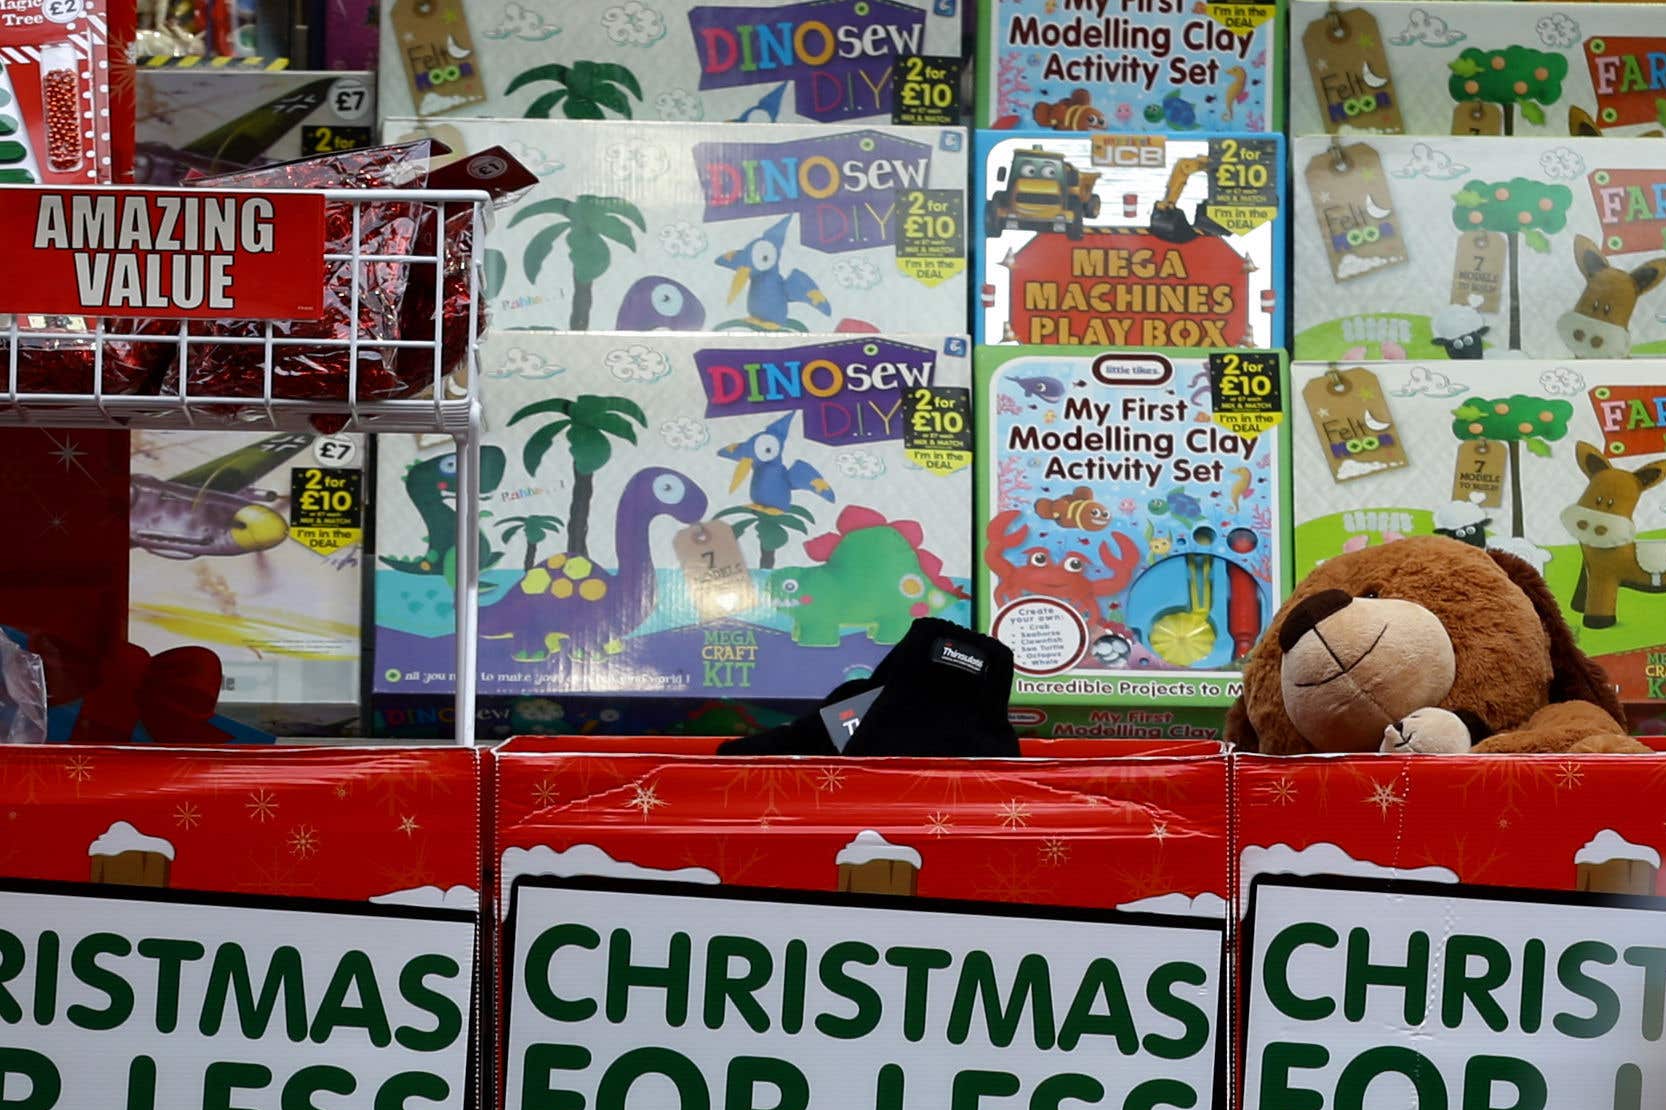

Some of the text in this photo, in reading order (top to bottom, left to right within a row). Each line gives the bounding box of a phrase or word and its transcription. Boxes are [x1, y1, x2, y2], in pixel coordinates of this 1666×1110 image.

[2, 13, 43, 26] Tree
[1009, 16, 1254, 59] Modelling Clay
[906, 57, 946, 79] 2 for
[1043, 53, 1220, 90] Activity Set
[811, 66, 893, 112] DIY
[901, 82, 952, 107] £10
[336, 91, 365, 111] £7
[315, 127, 356, 151] 2 for
[1221, 139, 1260, 161] 2 for
[1216, 164, 1268, 187] £10
[909, 191, 948, 213] 2 for
[34, 194, 275, 253] AMAZING
[816, 202, 896, 243] DIY
[904, 215, 956, 238] £10
[1072, 248, 1188, 279] MEGA
[74, 252, 235, 309] VALUE
[1024, 281, 1235, 315] MACHINES
[1030, 316, 1229, 347] PLAY BOX
[1223, 354, 1263, 374] 2 for
[1219, 376, 1272, 396] £10
[915, 389, 956, 409] 2 for
[820, 399, 902, 438] DIY
[1064, 397, 1188, 425] My First
[1241, 414, 1252, 422] in
[911, 413, 963, 433] £10
[1232, 424, 1262, 433] DEAL
[318, 442, 352, 460] £7
[1009, 425, 1258, 460] Modelling Clay
[1045, 456, 1223, 486] Activity Set
[1475, 460, 1486, 472] 7
[305, 469, 347, 489] 2 for
[299, 490, 353, 512] £10
[1018, 608, 1054, 616] Create
[703, 630, 757, 646] MEGA
[702, 646, 758, 660] CRAFT
[404, 671, 420, 682] all
[423, 672, 446, 685] you
[481, 671, 532, 682] to make
[703, 662, 756, 687] KIT
[1017, 679, 1113, 696] Incredible
[1120, 681, 1195, 700] Projects
[1201, 682, 1221, 696] to
[1091, 711, 1174, 724] My First
[1053, 723, 1217, 738] Modelling Clay
[524, 922, 1210, 1061] CHRISTMAS
